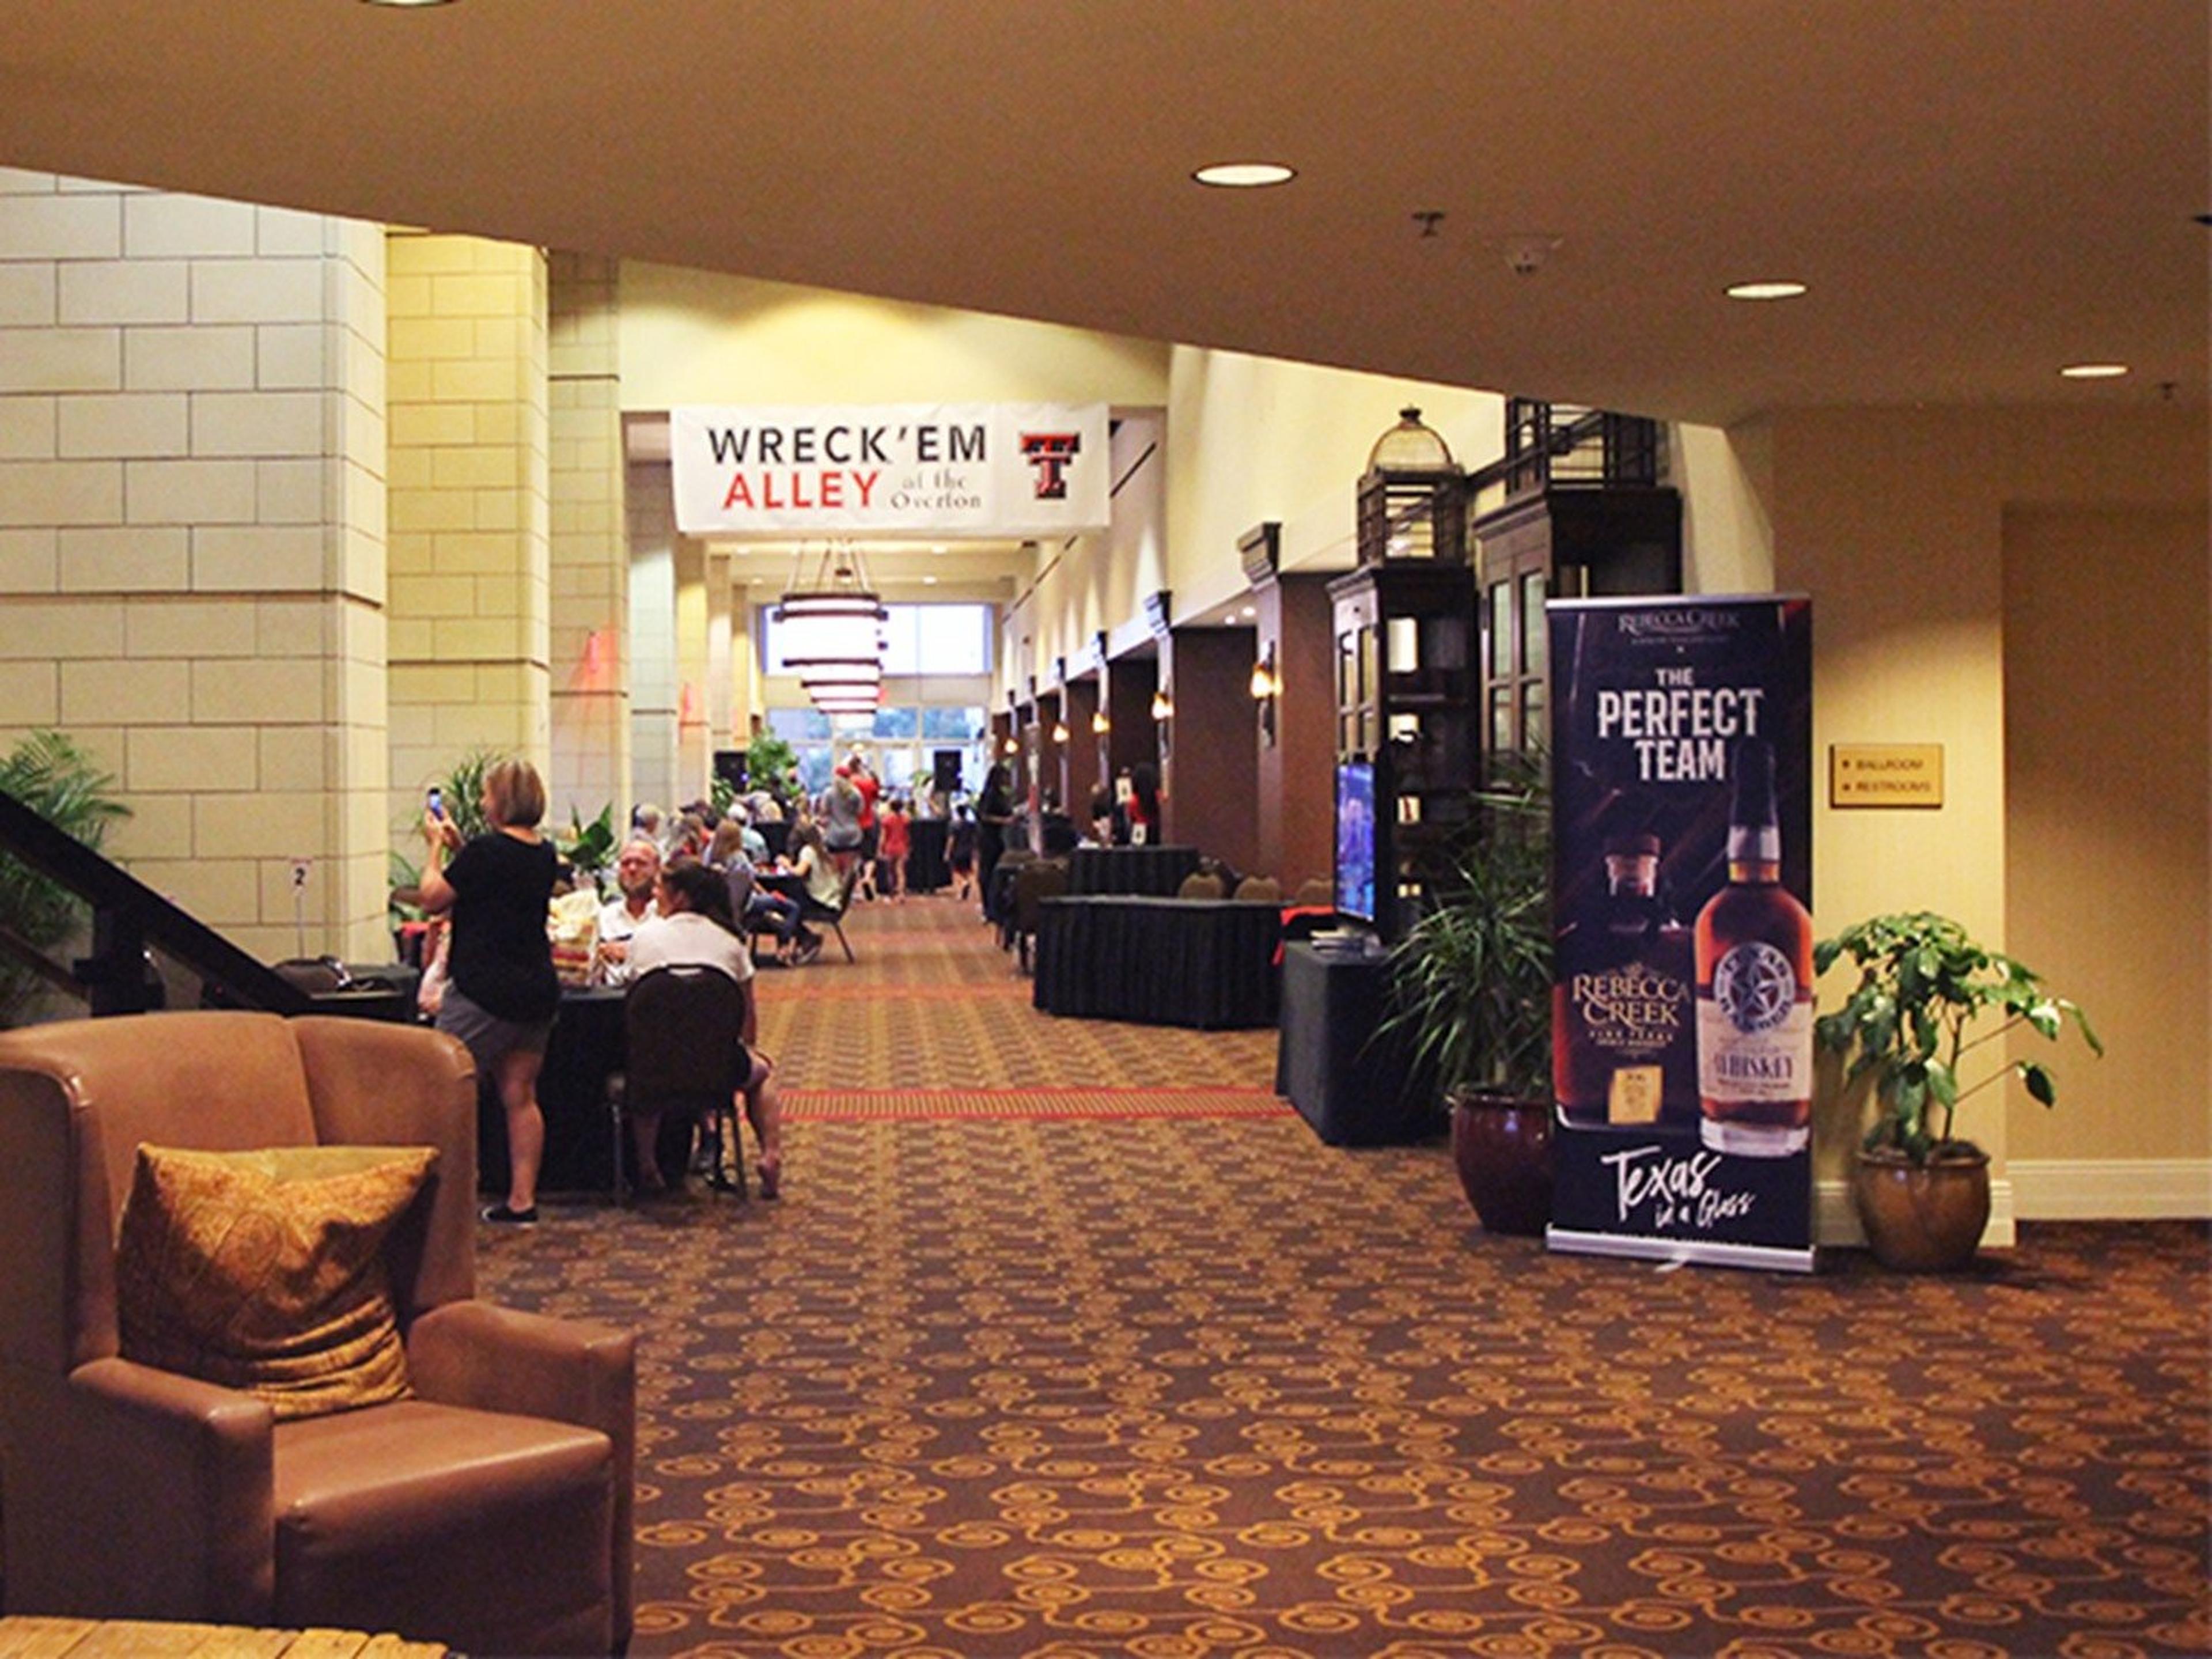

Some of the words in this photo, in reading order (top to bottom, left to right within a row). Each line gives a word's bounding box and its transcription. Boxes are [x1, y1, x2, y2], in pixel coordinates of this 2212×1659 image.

[724, 471, 880, 509] ALLEY
[1655, 668, 1692, 686] THE
[1597, 688, 1764, 738] PERFECT
[1634, 740, 1725, 781] TEAM
[295, 867, 305, 886] 2
[1573, 973, 1691, 1003] REBECCA
[1583, 1001, 1680, 1031] CREEK
[1601, 1145, 1722, 1222] Texas
